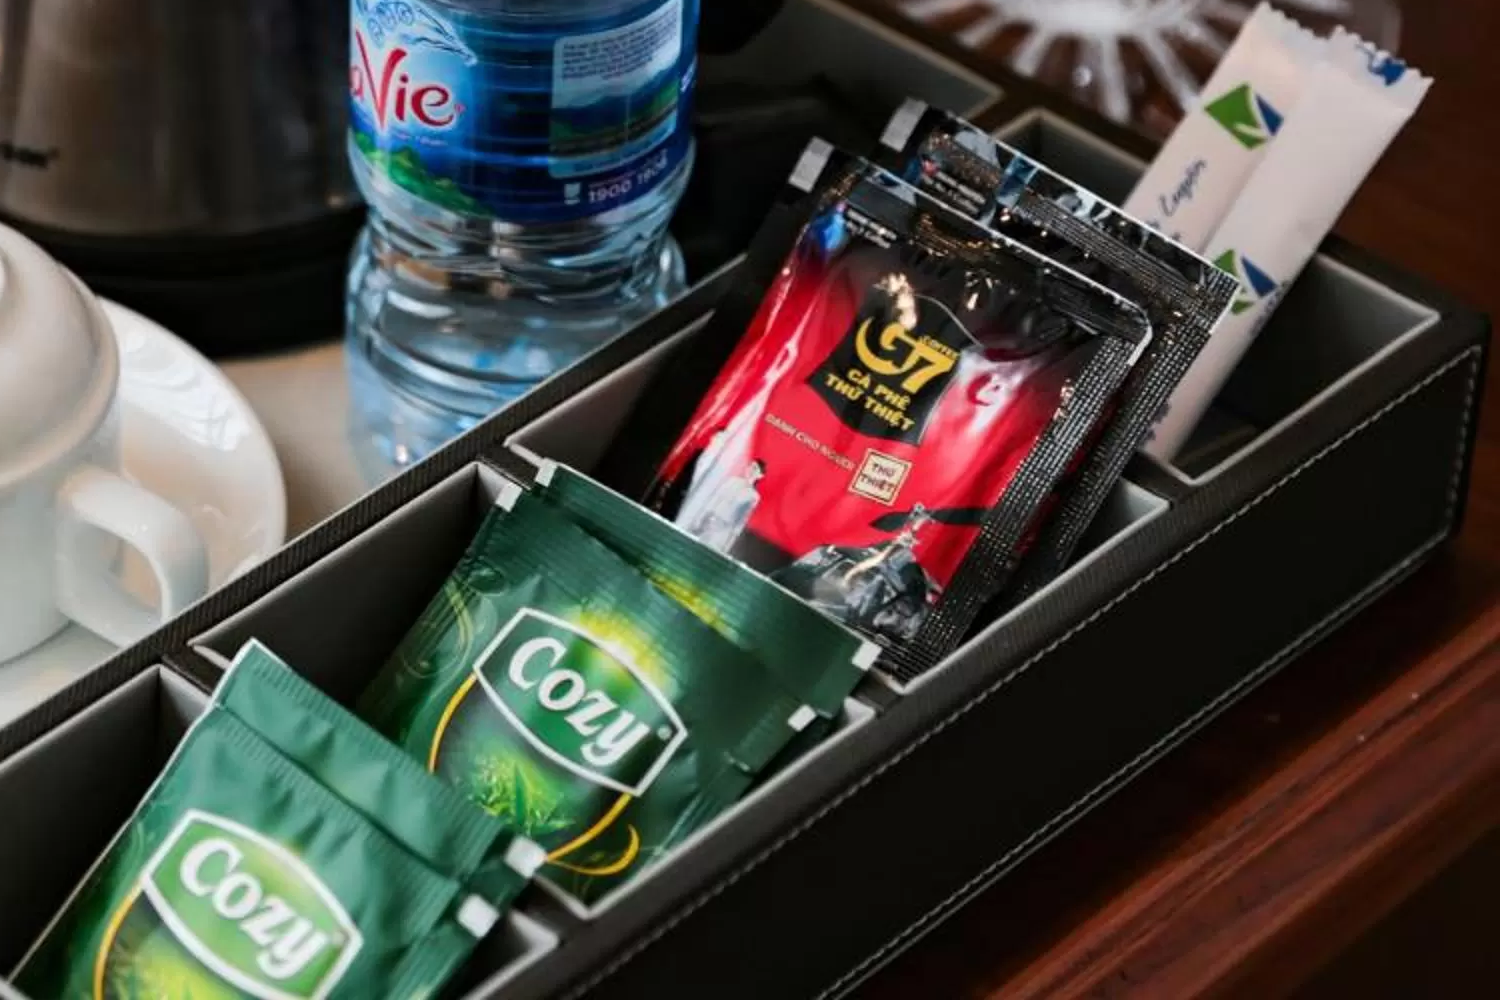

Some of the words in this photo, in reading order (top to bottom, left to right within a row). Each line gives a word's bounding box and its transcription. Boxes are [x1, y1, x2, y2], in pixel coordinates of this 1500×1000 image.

[349, 30, 455, 128] aVie
[855, 316, 958, 395] G7
[508, 636, 651, 766] Cozy
[179, 837, 329, 980] Cozy
